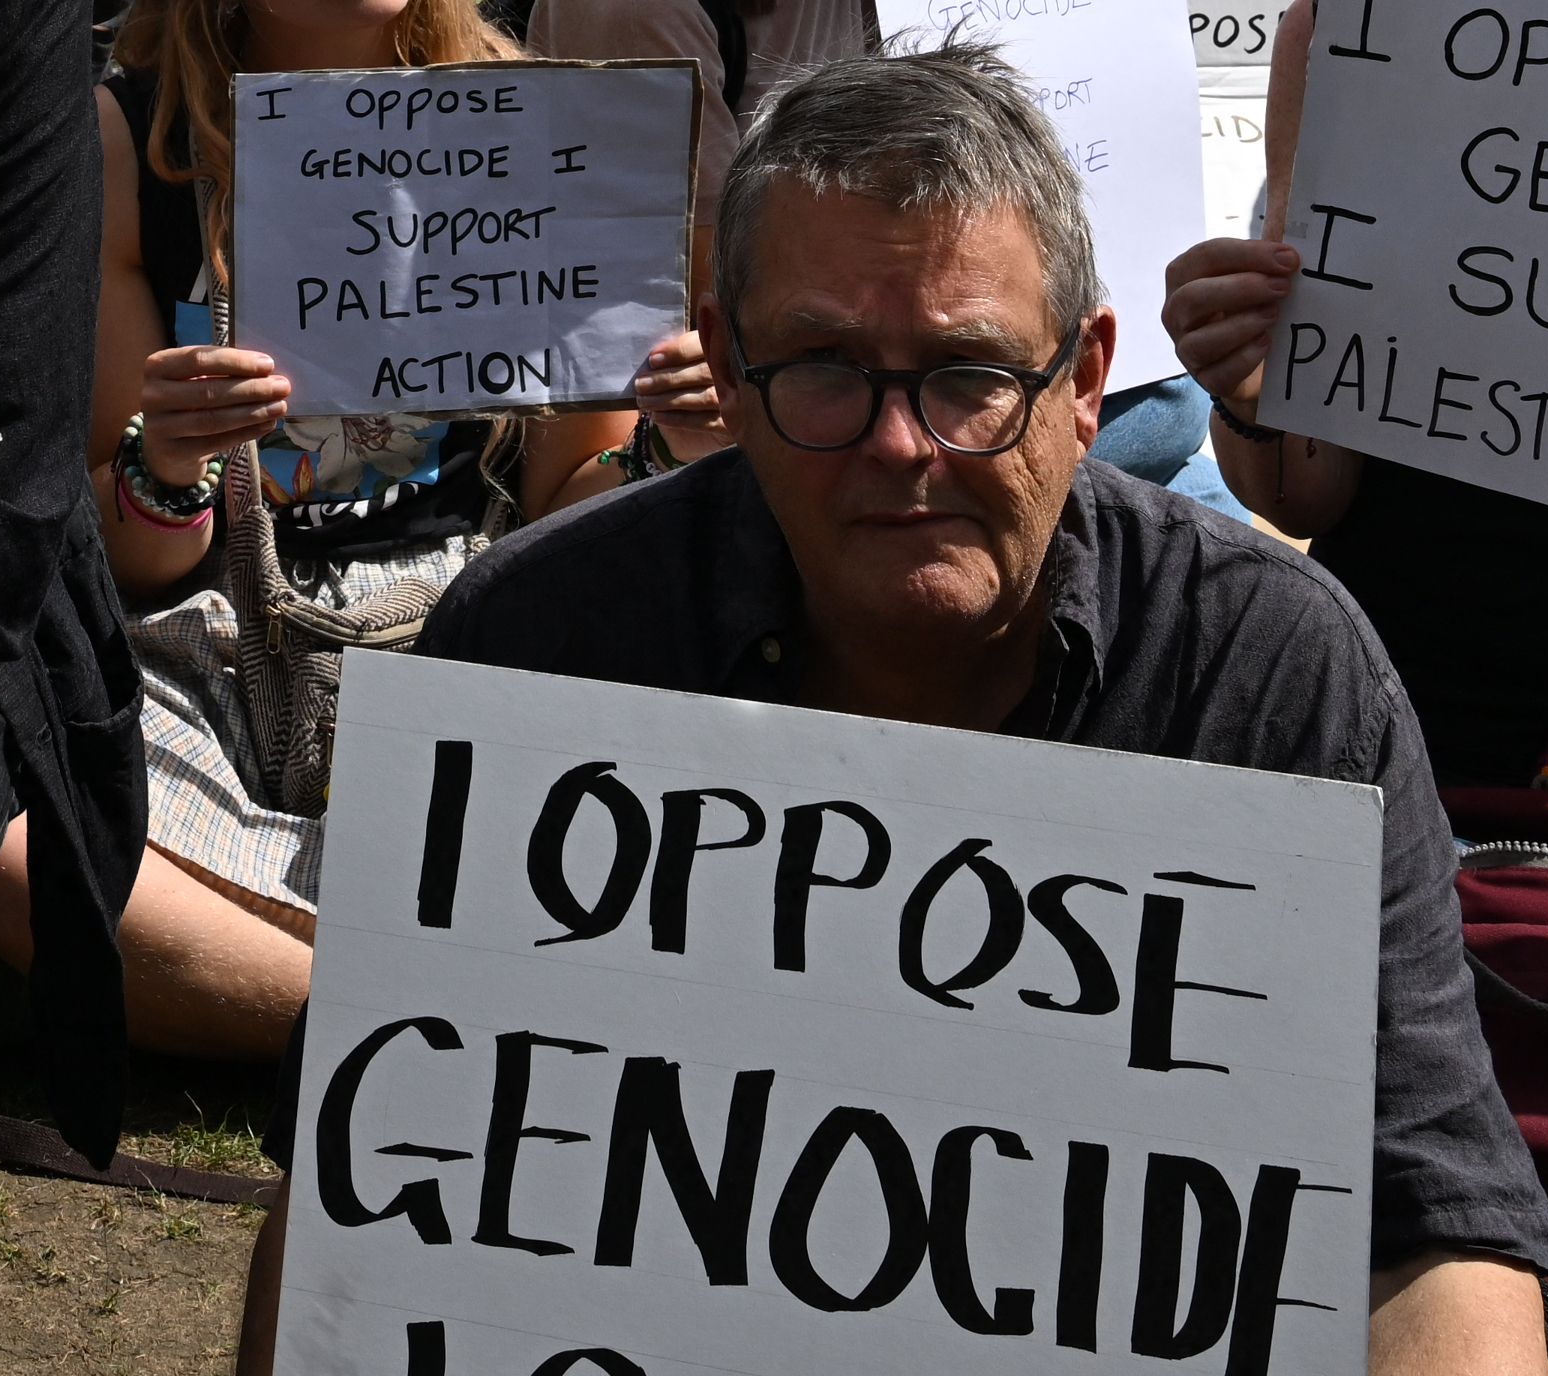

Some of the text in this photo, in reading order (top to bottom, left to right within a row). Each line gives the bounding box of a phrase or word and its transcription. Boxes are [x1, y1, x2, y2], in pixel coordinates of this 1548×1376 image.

[256, 86, 523, 130] I OPPOSE
[301, 145, 587, 179] GENOCIDE I
[346, 207, 556, 255] SUPPORT
[1301, 204, 1376, 290] I
[297, 265, 599, 330] PALESTINE
[372, 348, 553, 398] ACTION
[417, 740, 1269, 1074] I OPPOSE
[317, 1016, 1352, 1376] GENOCIDE
